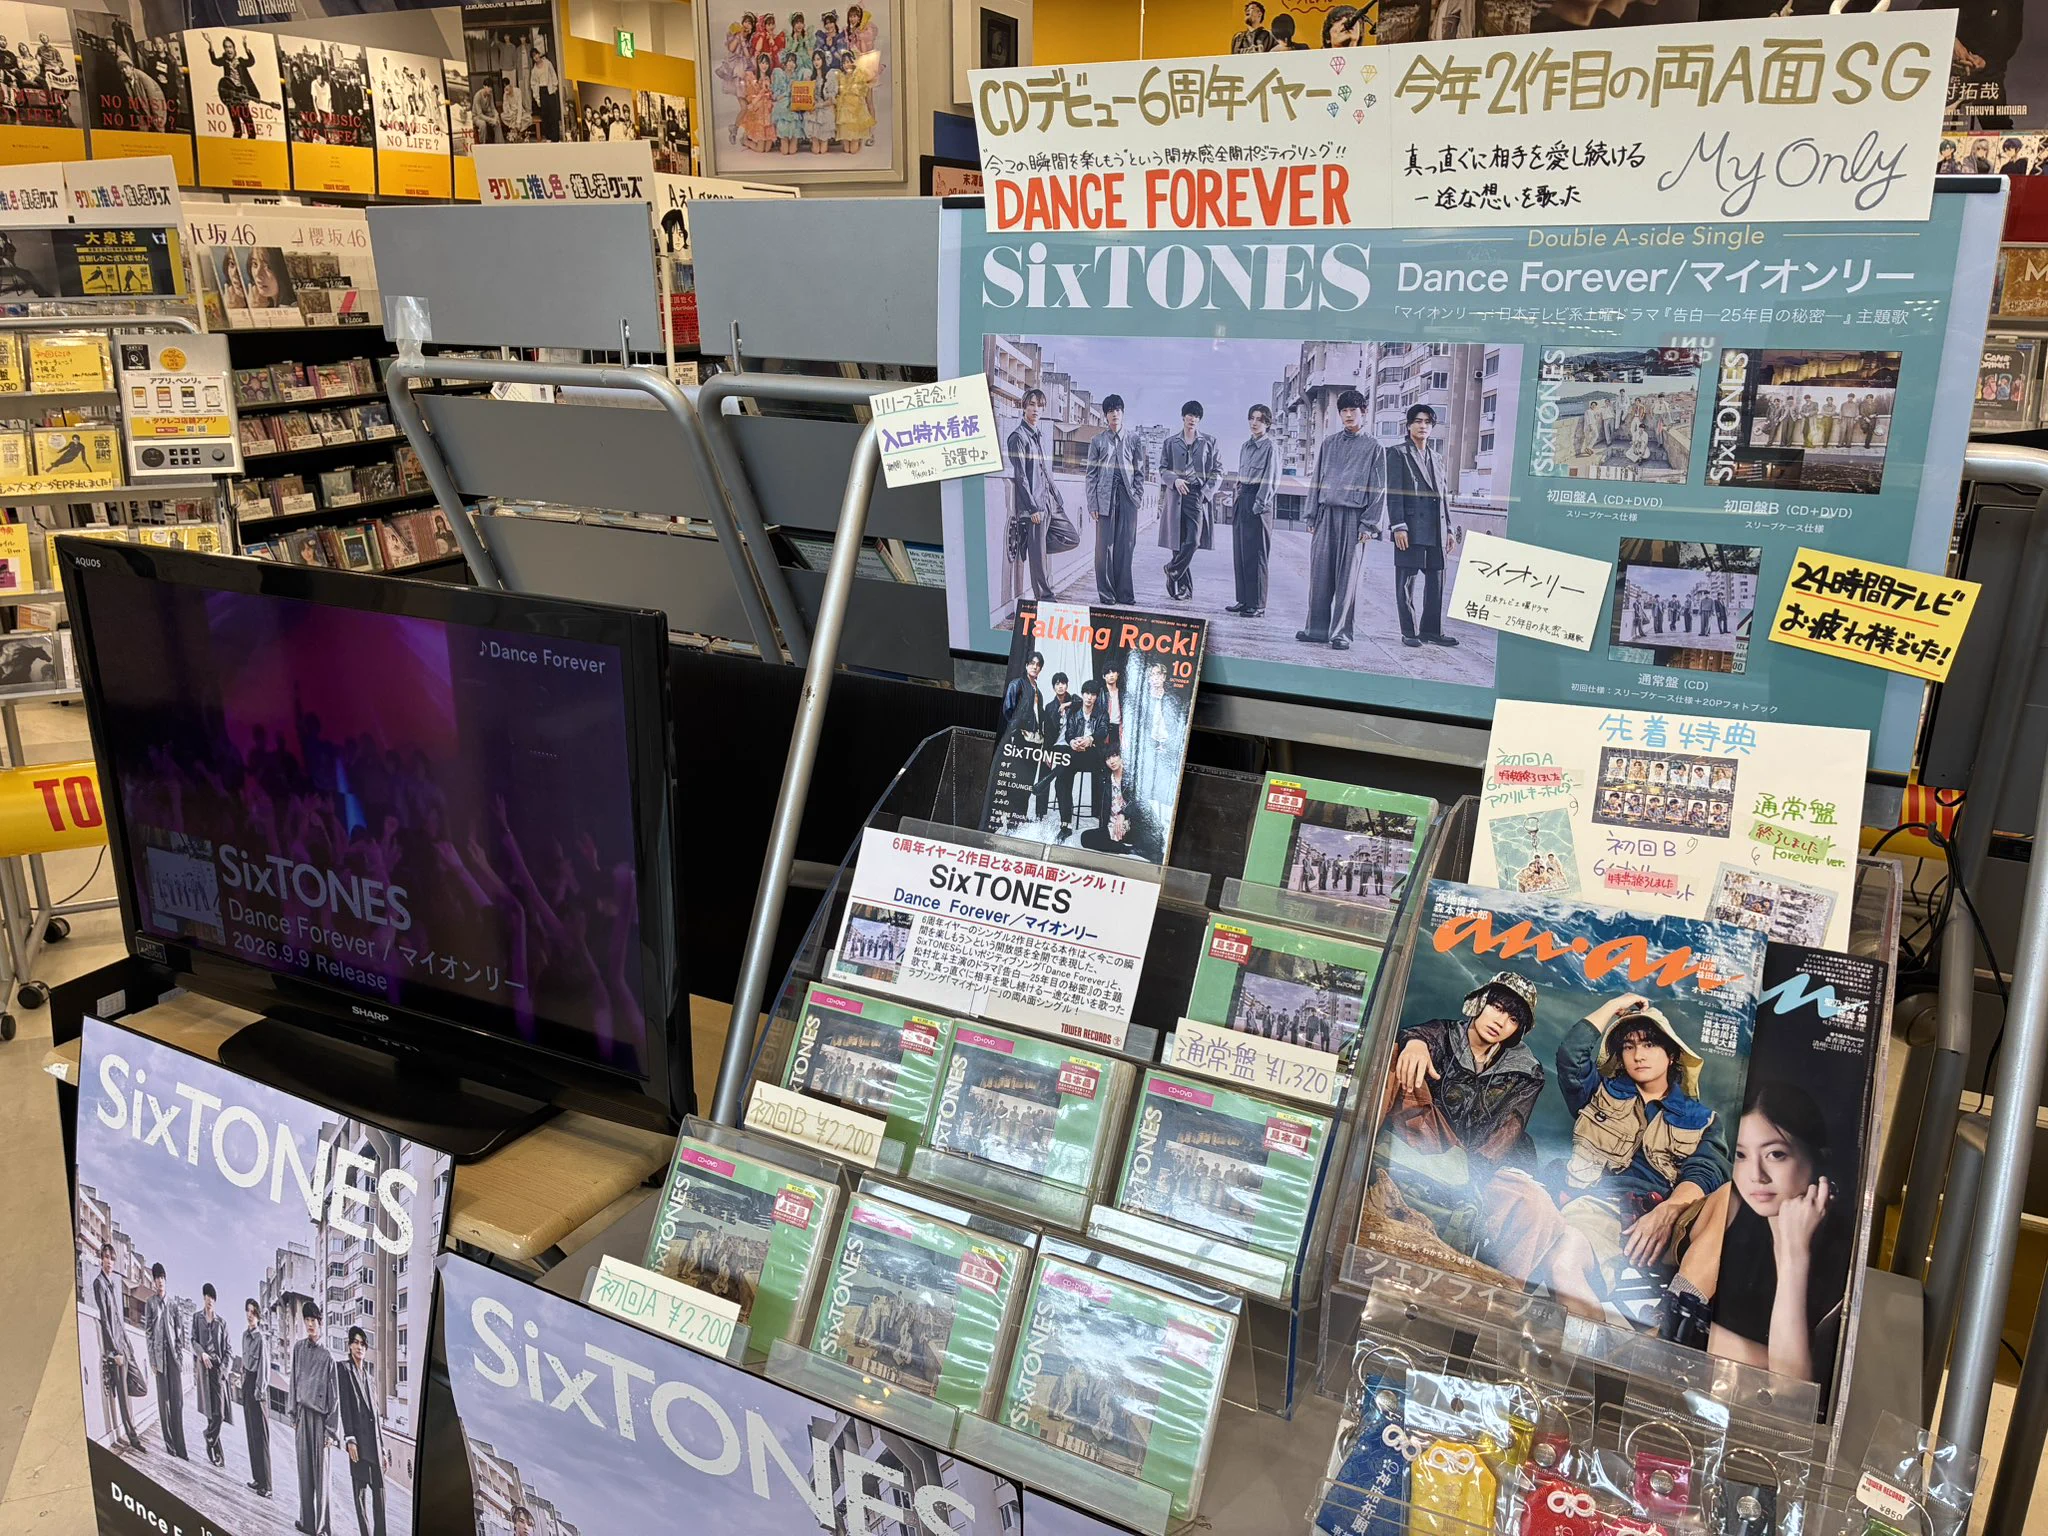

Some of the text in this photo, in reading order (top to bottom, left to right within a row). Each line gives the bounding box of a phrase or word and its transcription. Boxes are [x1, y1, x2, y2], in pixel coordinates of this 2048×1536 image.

[1395, 38, 1931, 116] 今年2作目の両A面SG
[100, 95, 122, 108] NO
[102, 112, 124, 126] NO
[206, 102, 279, 122] NO MUSIC,
[980, 64, 1332, 137] CDデビュー6周年イヤー
[208, 119, 227, 133] NO
[386, 135, 404, 148] NO
[1403, 139, 1647, 176] 真っ直ぐに相手を愛し続ける
[1657, 130, 1910, 218] My Only
[996, 164, 1352, 231] DANCE FOREVER
[1414, 182, 1582, 210] 一途な想いを歌った
[84, 231, 137, 246] 大泉洋
[1527, 226, 1765, 250] Double A-side Single
[982, 241, 1371, 313] SixTONES
[1396, 257, 1915, 296] Dance Forever/マイオンリー
[1534, 349, 1566, 474] SixTONES
[1710, 351, 1750, 483] SixTONES
[882, 415, 980, 452] 入口特大看板
[1546, 489, 1598, 505] 初回盤A
[1723, 499, 1780, 516] 初回盤B
[75, 556, 101, 568] AQUOS
[1470, 560, 1585, 598] マイオンリー
[1790, 561, 1965, 616] 24時間テレビ
[1020, 612, 1111, 650] Talking
[1119, 623, 1199, 658] Rock!
[1779, 603, 1951, 667] お疲れ様でした!
[489, 641, 606, 675] Dance Forever
[1172, 660, 1193, 679] 10
[1637, 672, 1680, 689] 通常盤
[1598, 713, 1757, 755] 先着特典
[1003, 743, 1071, 767] SixTONES
[1752, 792, 1838, 825] 通常盤
[218, 844, 413, 931] SixTONES
[894, 888, 941, 911] Dance
[930, 864, 1072, 914] SixTONES
[228, 899, 292, 936] Dance
[298, 916, 376, 958] Forever
[399, 946, 525, 992] マイオンリー
[232, 931, 388, 991] 2026.9.9 Release
[351, 1005, 390, 1023] SHARP
[1060, 1022, 1112, 1045] TOWER RECORDS
[1176, 1029, 1329, 1094] 通常盤 ¥1,320
[1168, 1085, 1194, 1098] CD+DVD
[815, 1113, 875, 1156] ¥2,200
[97, 1053, 419, 1256] SixTONES
[597, 1265, 733, 1349] 初回A ¥2,200
[819, 1237, 864, 1355] SixTONES
[1008, 1301, 1057, 1428] SixTONES
[470, 1296, 976, 1536] SixTONES
[111, 1481, 168, 1534] Dance
